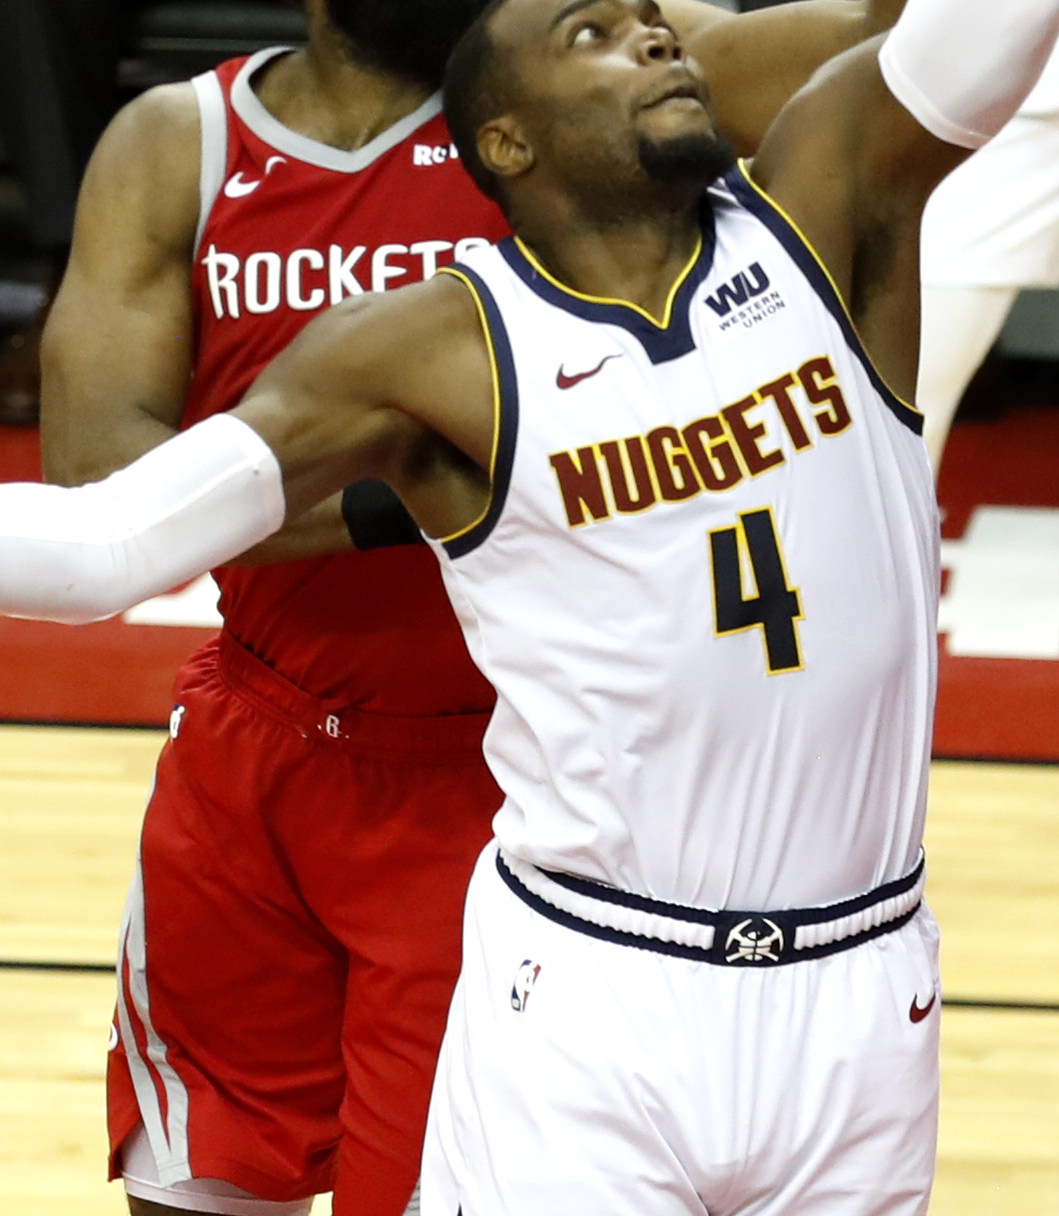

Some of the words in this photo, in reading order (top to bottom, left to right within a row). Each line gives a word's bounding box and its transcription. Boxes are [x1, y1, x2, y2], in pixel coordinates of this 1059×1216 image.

[704, 261, 770, 318] WU
[719, 291, 780, 332] WESTERN
[743, 300, 786, 329] UNION
[549, 355, 853, 529] NUGGETS
[709, 506, 806, 676] 4
